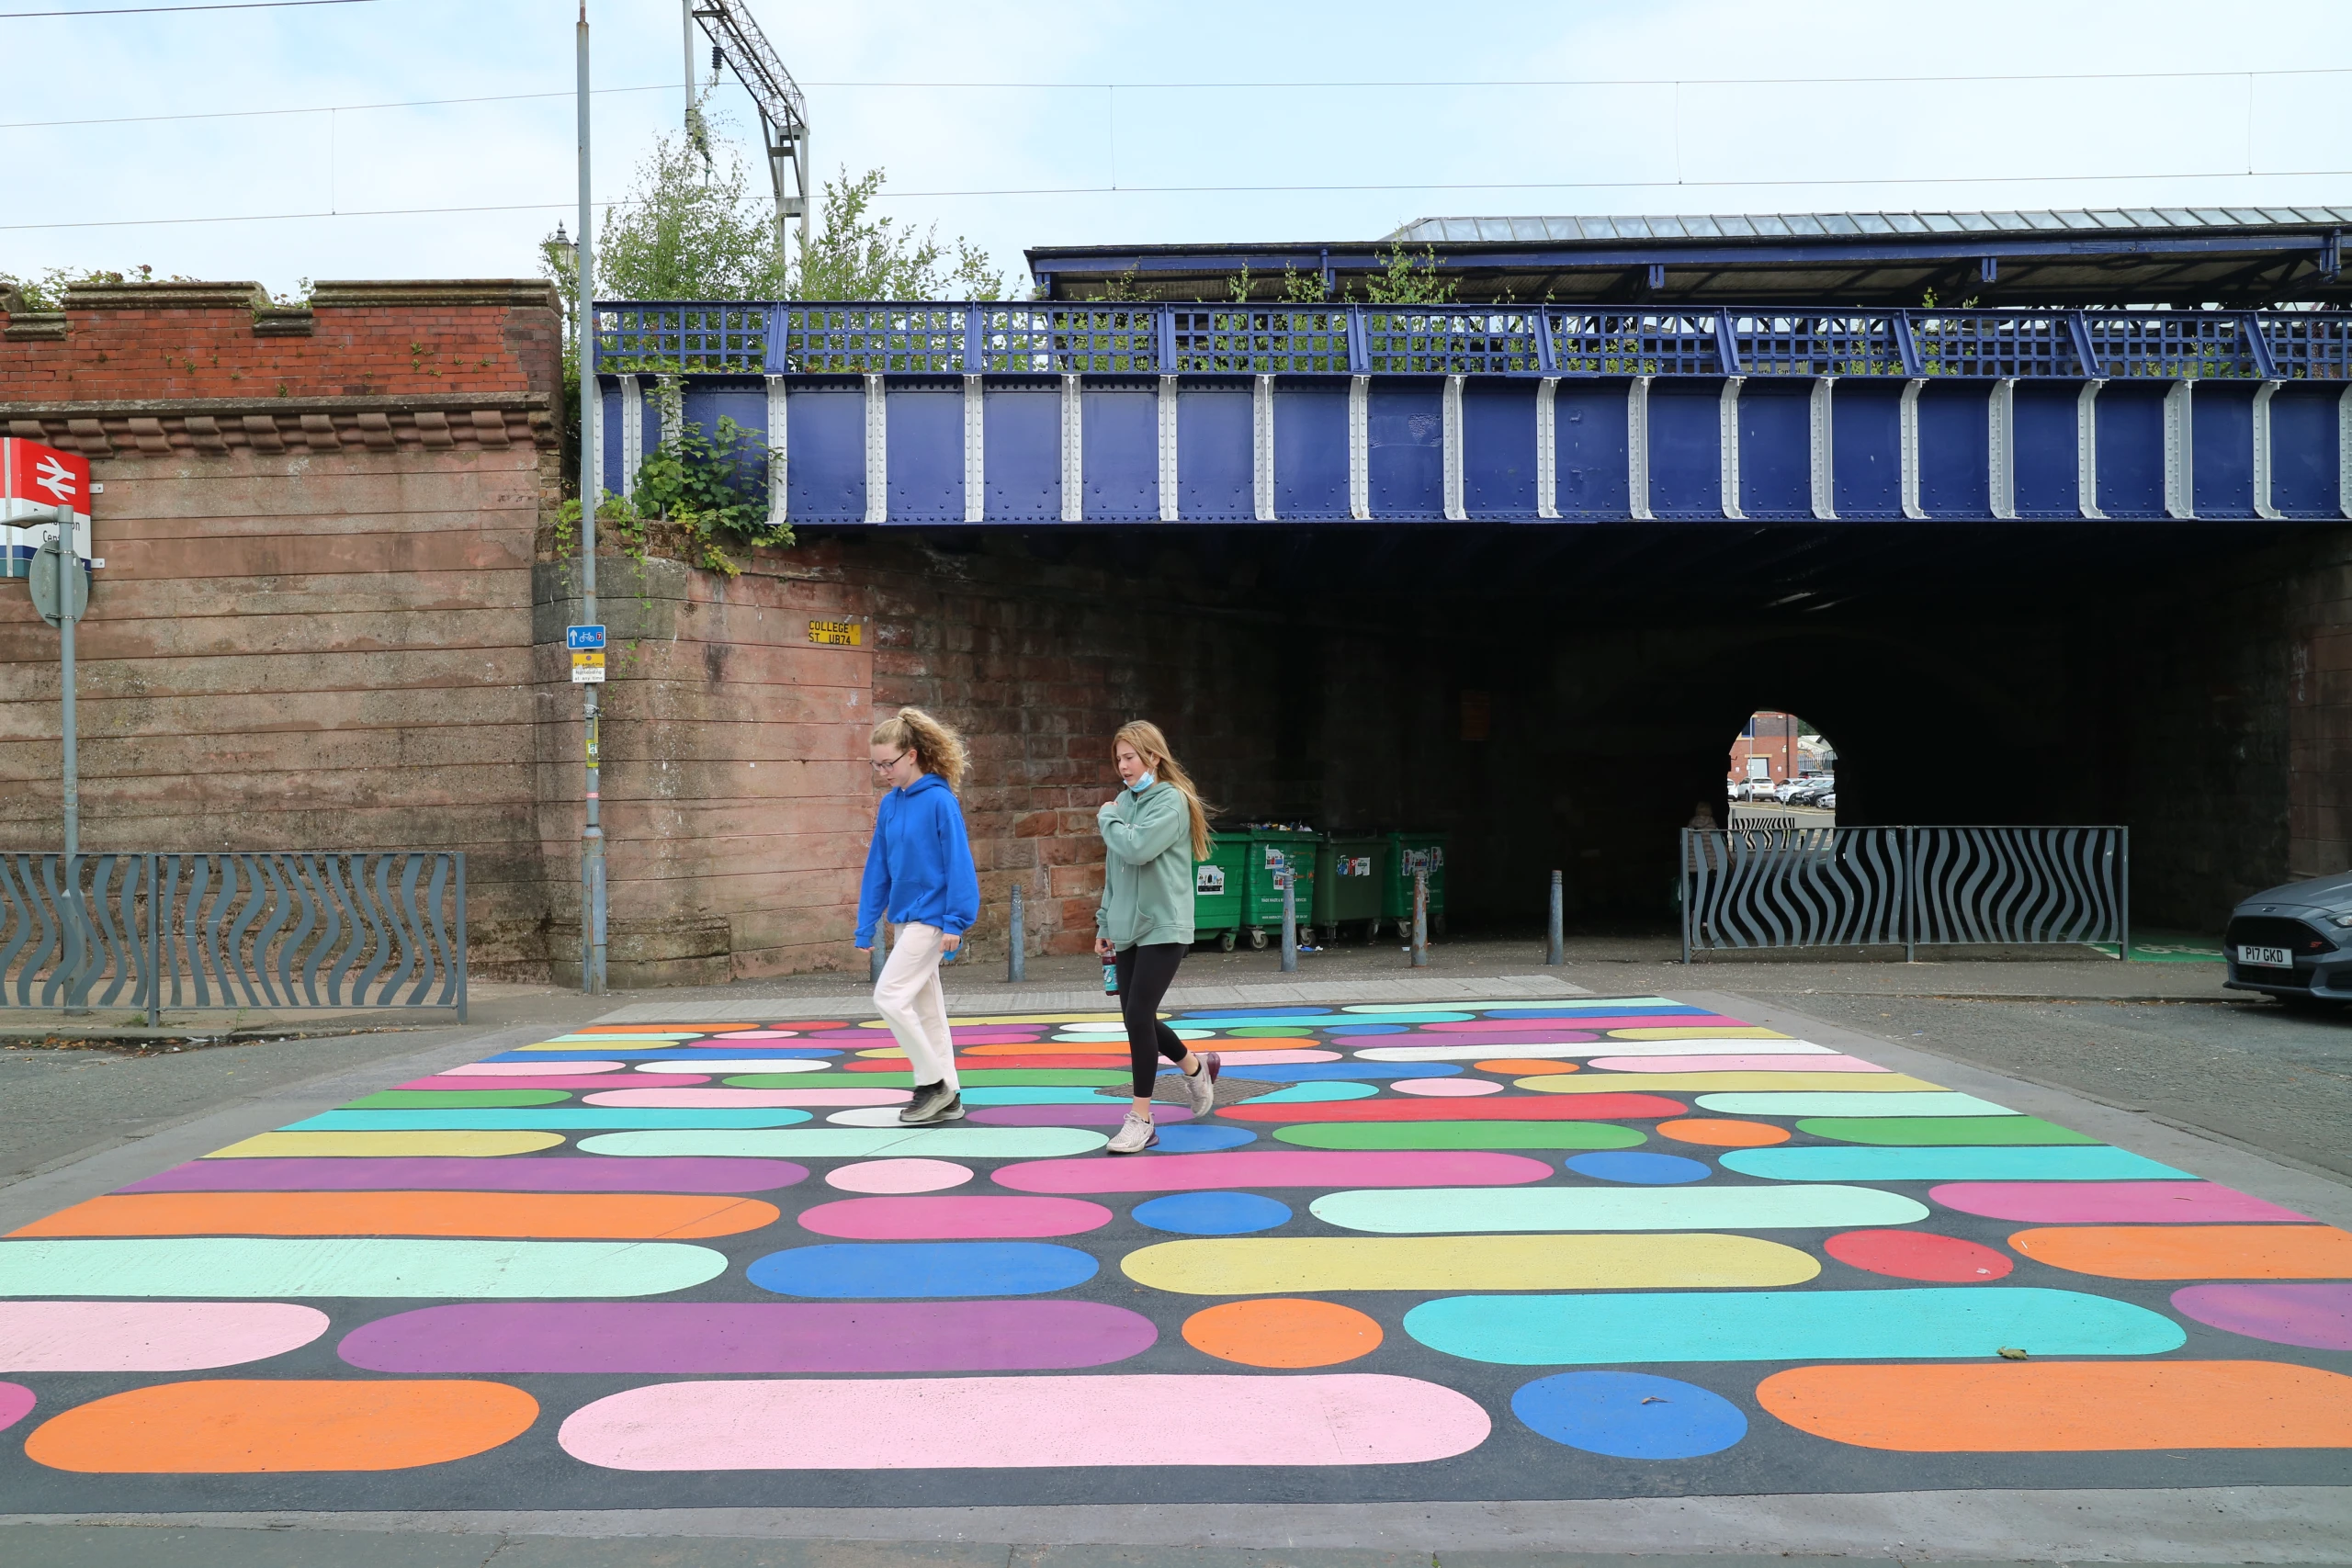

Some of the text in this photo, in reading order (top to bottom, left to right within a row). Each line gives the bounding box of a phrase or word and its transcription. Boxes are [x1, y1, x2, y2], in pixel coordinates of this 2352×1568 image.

[808, 620, 849, 633] COLLEGE
[808, 633, 851, 645] ST UB74
[2245, 946, 2284, 964] P17 GKD
